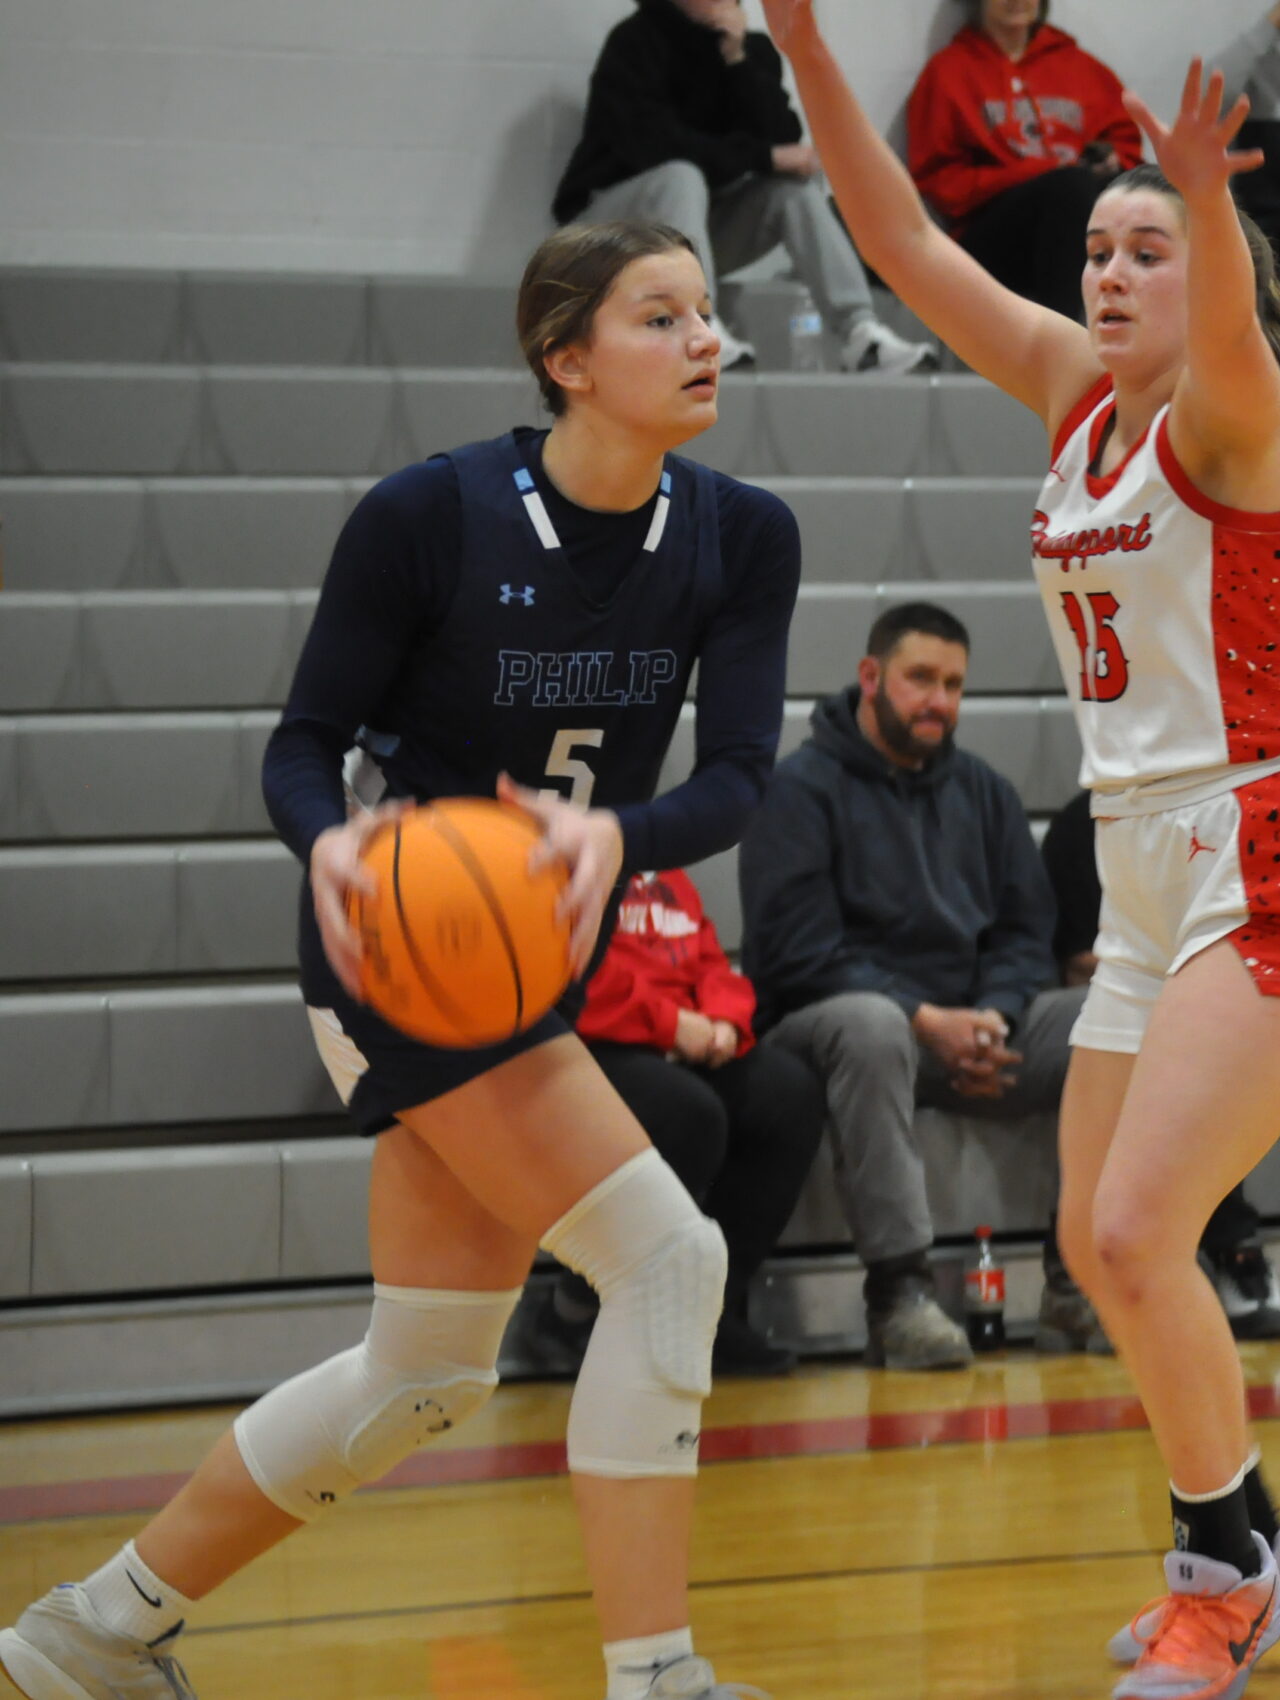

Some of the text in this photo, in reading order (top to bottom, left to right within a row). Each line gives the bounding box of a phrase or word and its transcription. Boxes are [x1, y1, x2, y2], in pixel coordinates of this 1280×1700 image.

[494, 649, 678, 708] PHILIP
[1059, 591, 1130, 703] 15
[537, 728, 605, 816] 5
